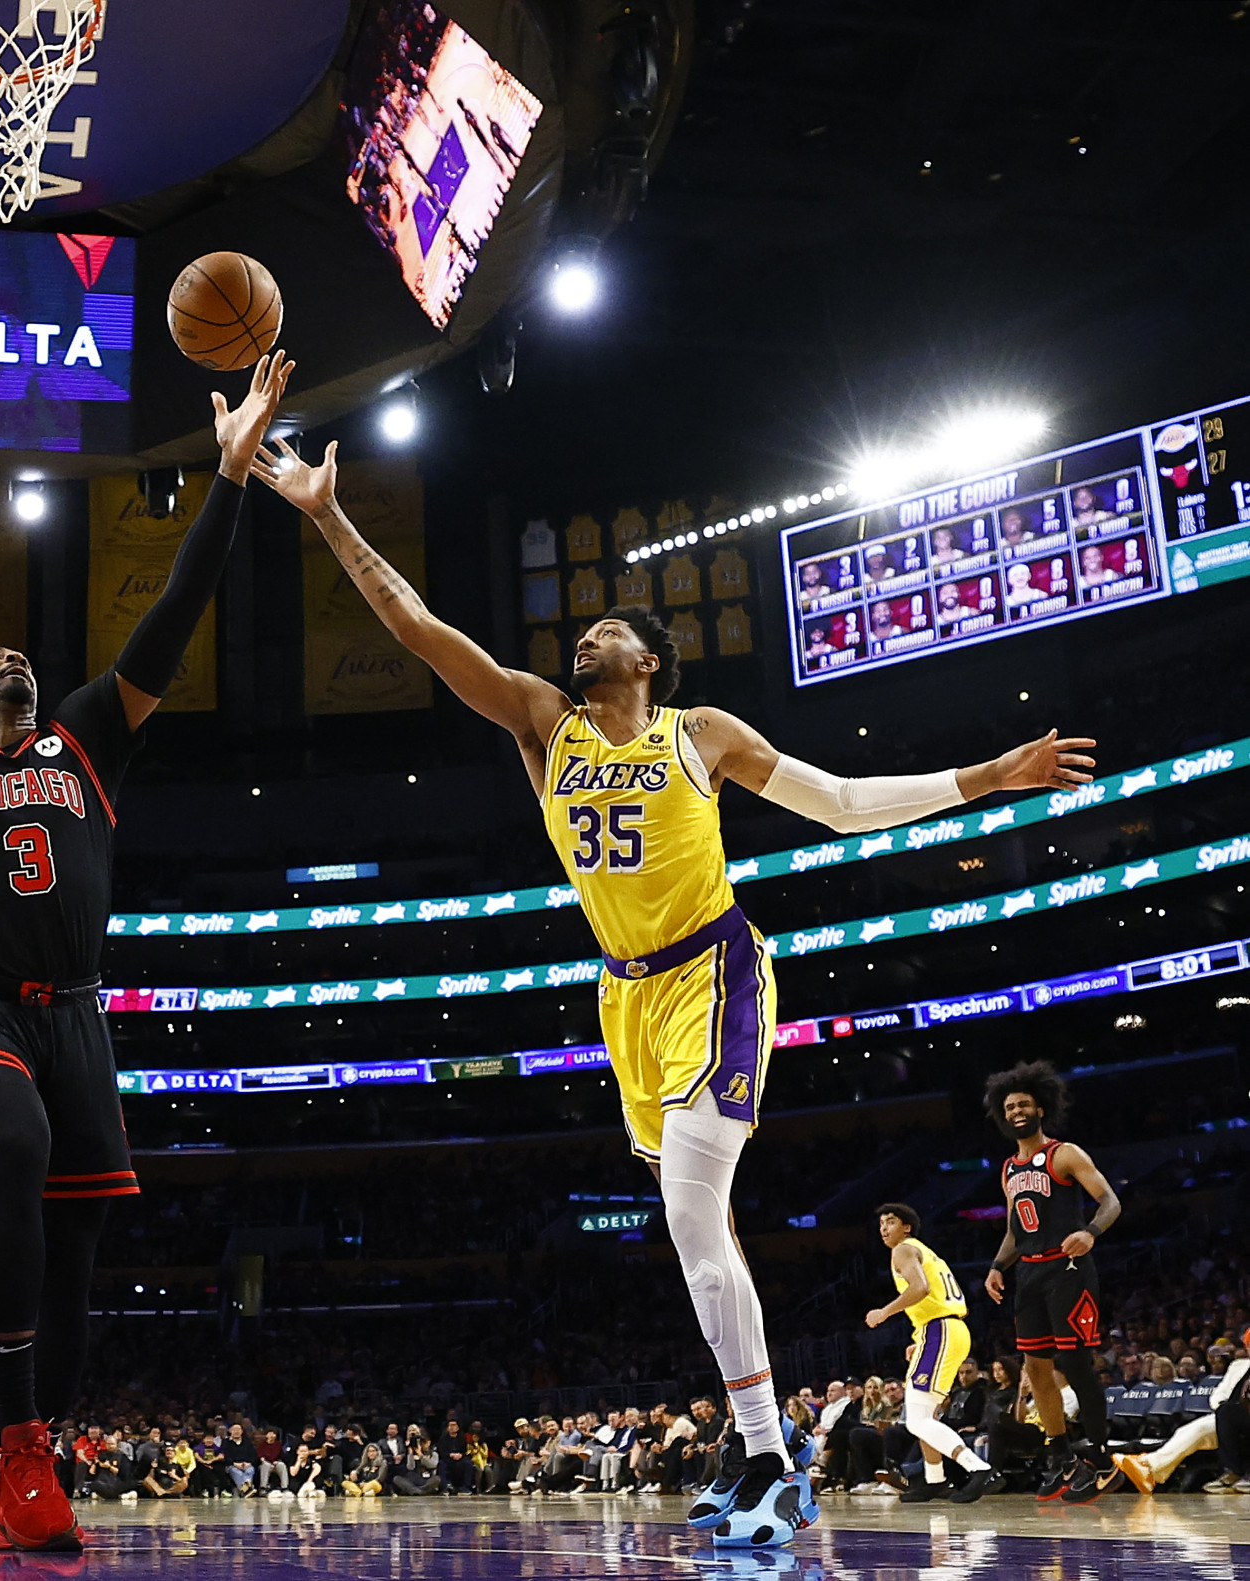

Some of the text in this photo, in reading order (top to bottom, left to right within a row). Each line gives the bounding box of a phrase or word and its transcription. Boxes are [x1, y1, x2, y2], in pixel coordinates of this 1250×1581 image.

[1203, 417, 1224, 442] 29
[1208, 450, 1226, 475] 27
[1116, 478, 1129, 499] 0
[1231, 481, 1250, 510] 1:
[900, 472, 1018, 528] ON THE COURT
[1043, 499, 1055, 519] 5
[973, 519, 985, 539] 0
[905, 538, 916, 557] 2
[1125, 539, 1138, 560] 8
[840, 556, 850, 575] 3
[1051, 558, 1063, 579] 8
[980, 577, 992, 598] 0
[911, 595, 923, 614] 0
[1031, 596, 1067, 616] CARUSO
[845, 613, 857, 632] 3
[960, 614, 994, 632] CARTER
[884, 629, 934, 652] DRUMMOND
[828, 648, 856, 666] WHITE
[642, 743, 671, 752] bibigo
[553, 754, 670, 797] LAKERS
[1170, 749, 1235, 783] Sprite
[1047, 784, 1106, 816] Sprite
[568, 803, 646, 874] 35
[906, 820, 964, 849] Sprite
[3, 822, 56, 896] 3
[790, 844, 845, 872] Sprite
[1195, 837, 1250, 872] Sprit
[307, 864, 357, 875] AMERICAN
[314, 871, 357, 881] EXPRESS
[545, 886, 580, 908] Spri
[1047, 874, 1107, 906] Sprite
[308, 906, 361, 928] Sprite
[416, 899, 470, 921] Sprite
[928, 902, 988, 931] Sprite
[180, 914, 234, 935] Sprite
[789, 926, 846, 955] Sprite
[544, 962, 599, 986] Sprite
[1160, 953, 1212, 980] 8:01
[306, 983, 360, 1005] Sprite
[436, 974, 490, 997] Sprite
[1053, 974, 1118, 998] crypto.com
[200, 989, 253, 1010] Sprite
[929, 993, 1009, 1020] Spectrum
[854, 1013, 900, 1030] TOYOTA
[171, 1075, 232, 1088] DELTA
[359, 1066, 418, 1079] crypto.com
[1015, 1198, 1040, 1233] 0
[939, 1271, 964, 1301] 10
